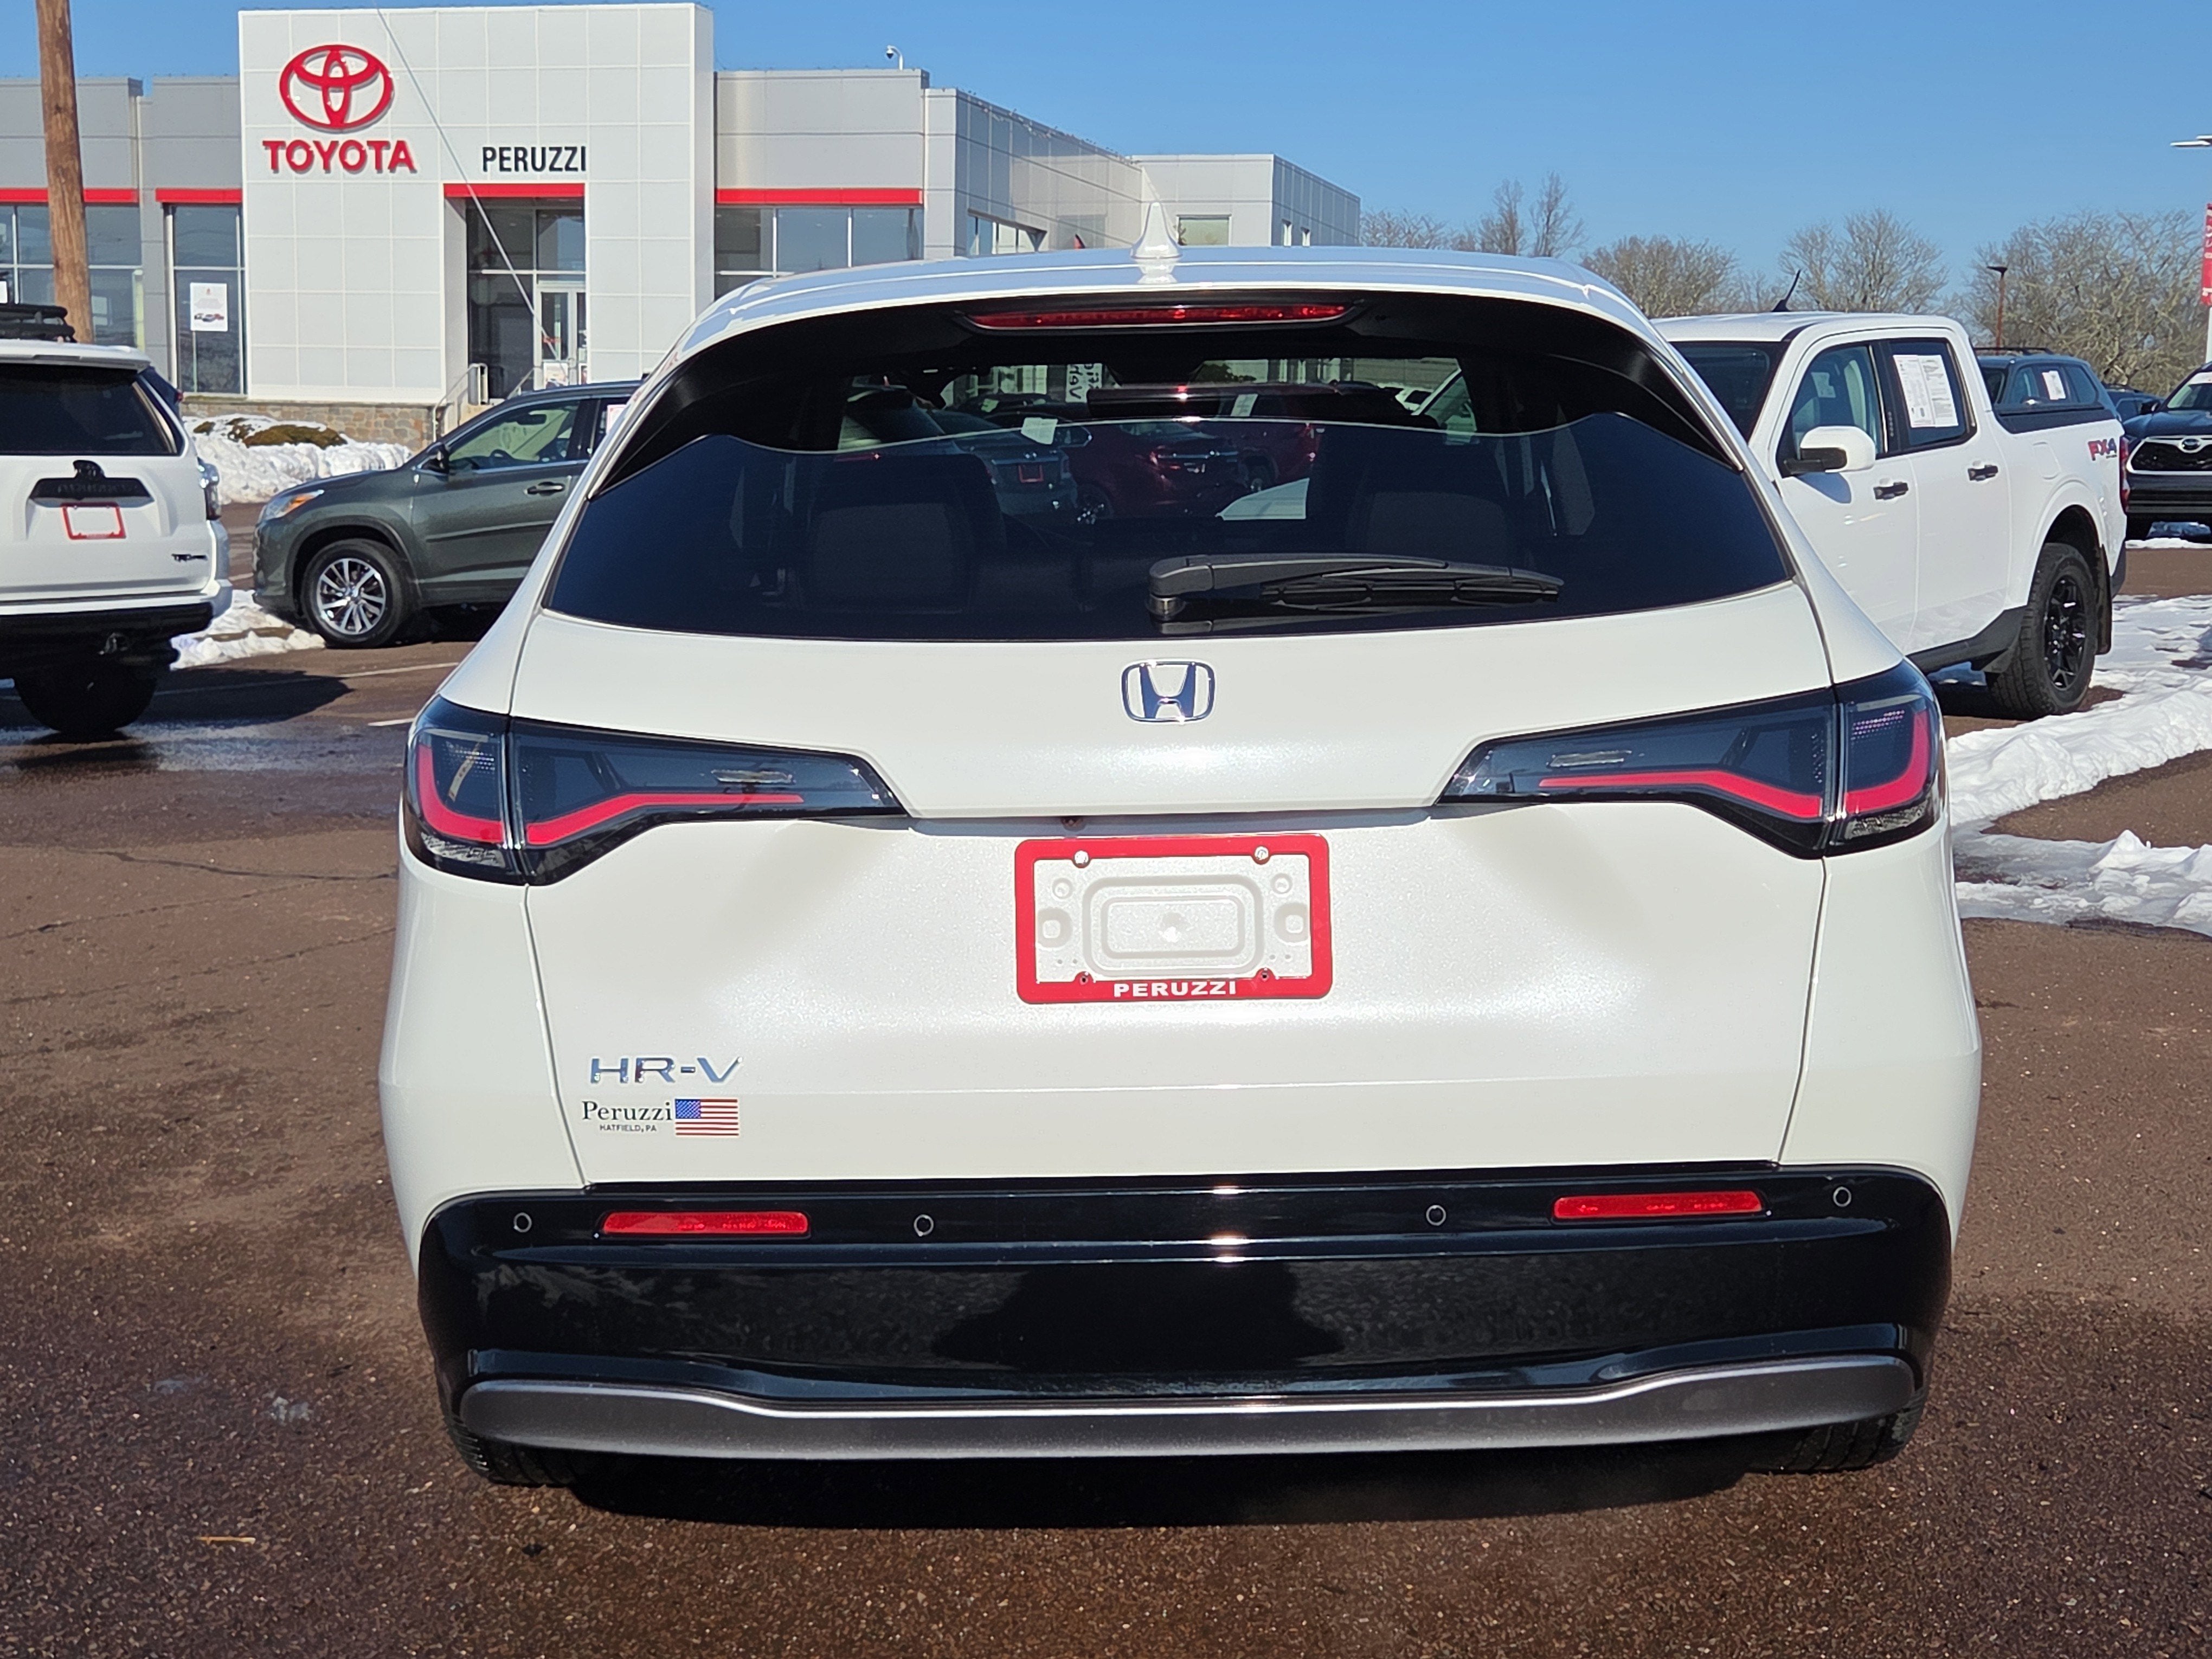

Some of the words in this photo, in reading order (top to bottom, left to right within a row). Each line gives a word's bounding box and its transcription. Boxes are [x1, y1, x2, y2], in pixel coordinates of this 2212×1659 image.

[262, 139, 417, 174] TOYOTA
[483, 146, 586, 172] PERUZZI
[1114, 981, 1236, 998] PERUZZI
[590, 1057, 742, 1083] HR-V
[582, 1101, 673, 1121] Peruzzi
